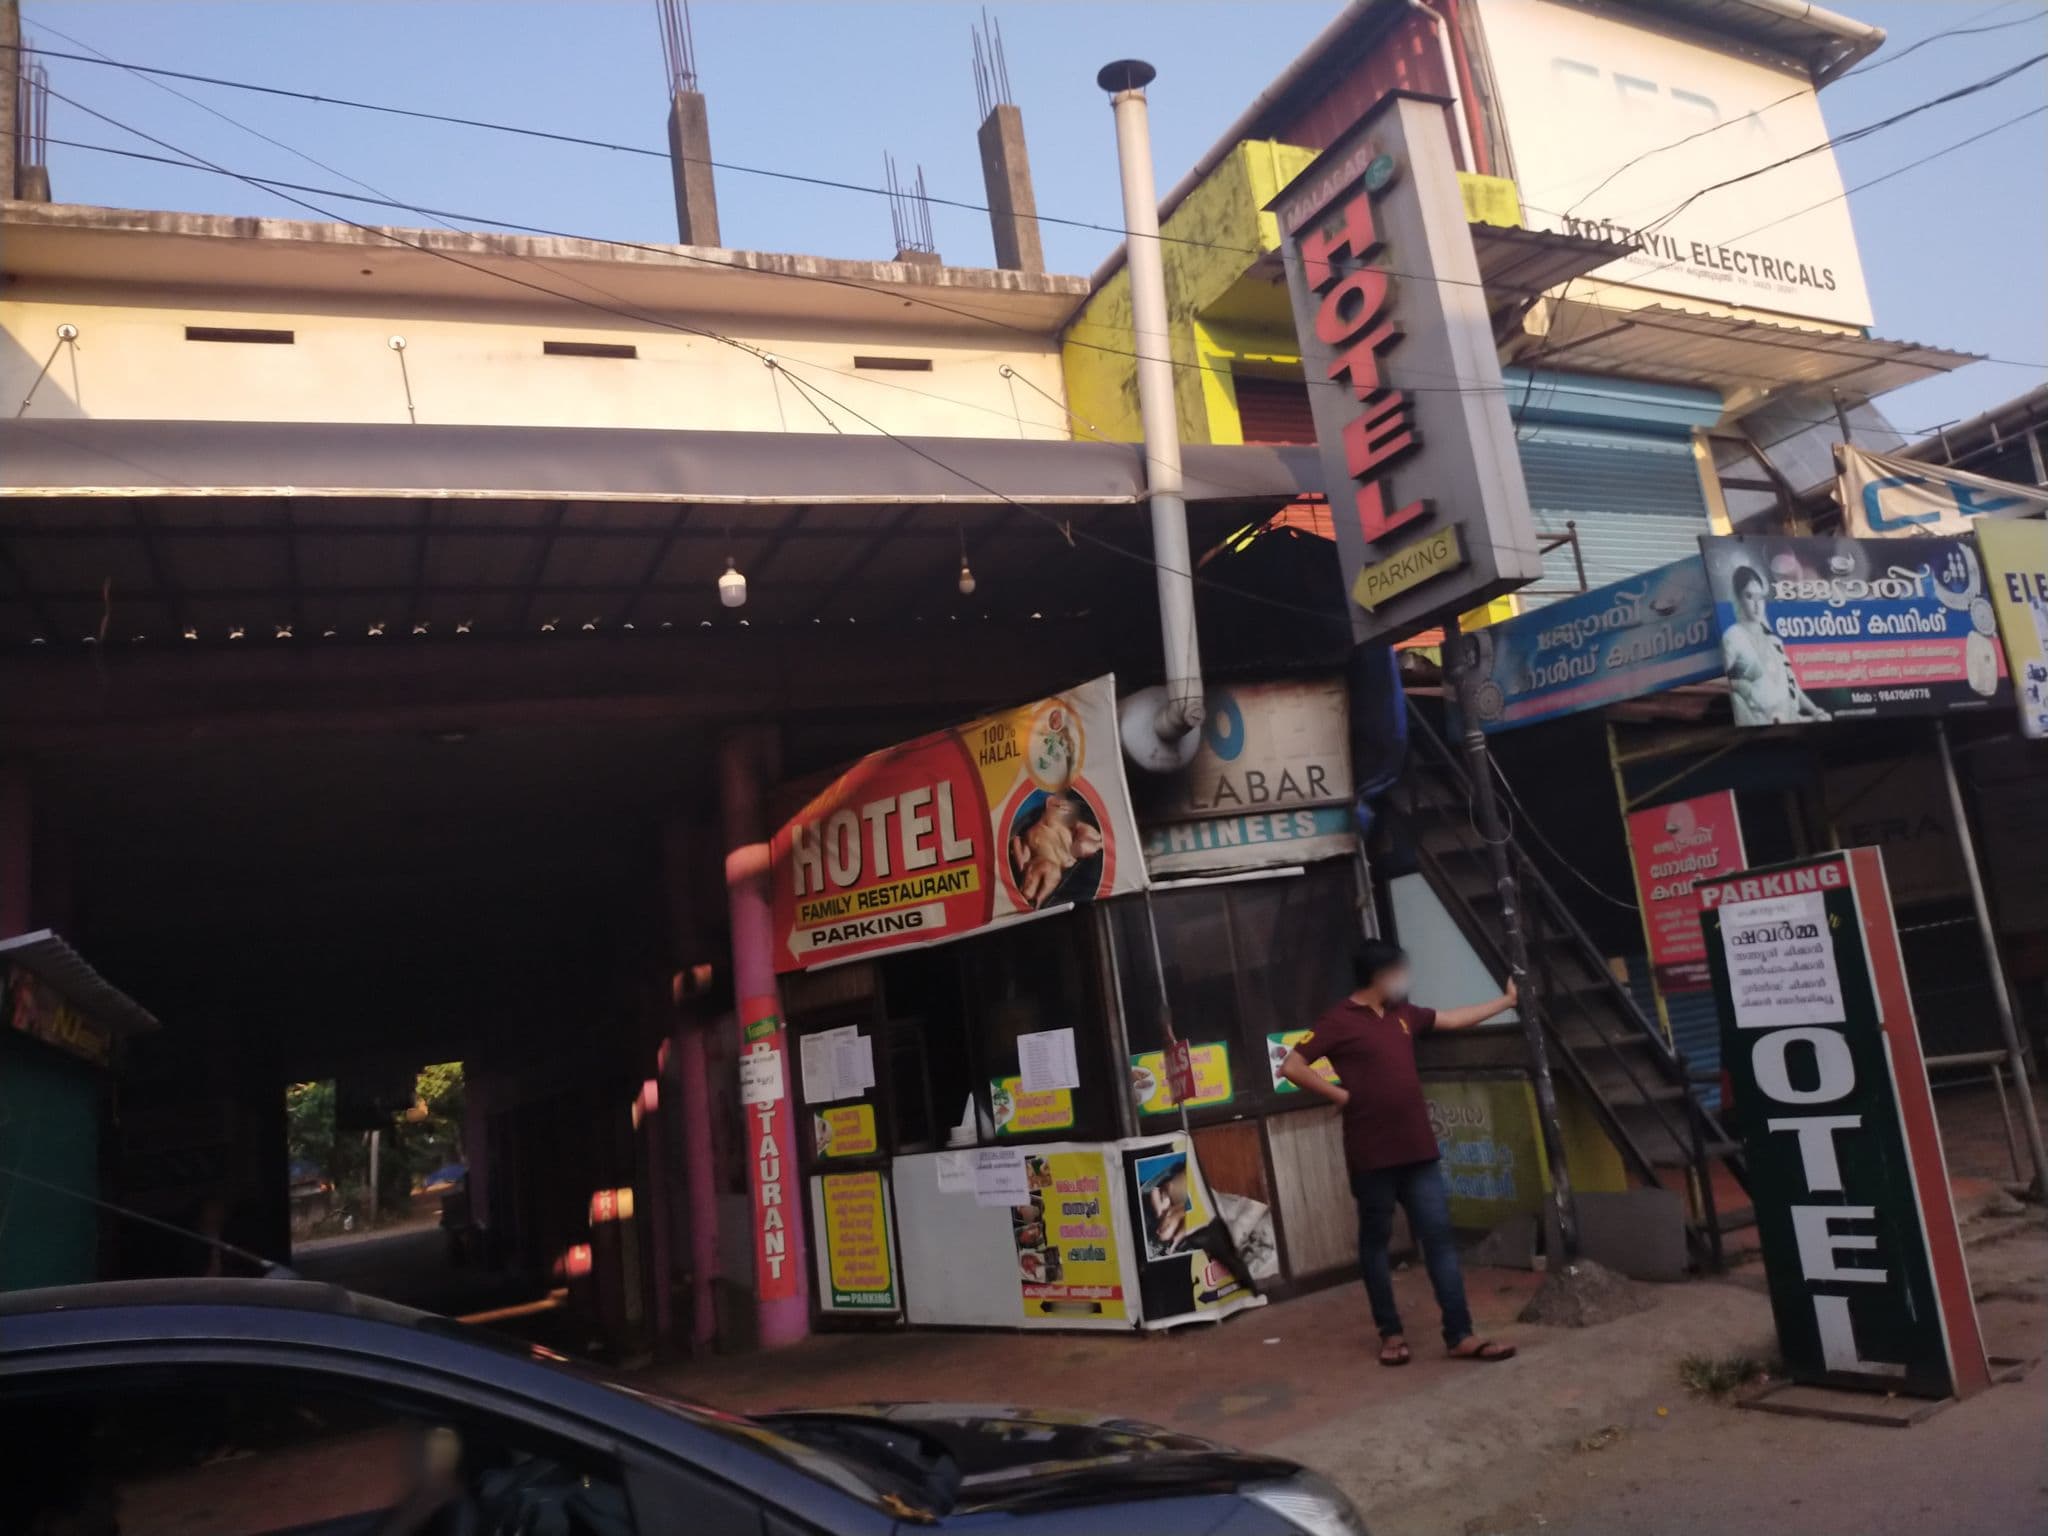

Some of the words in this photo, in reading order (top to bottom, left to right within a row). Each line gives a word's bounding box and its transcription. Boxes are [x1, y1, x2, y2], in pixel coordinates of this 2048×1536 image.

[1691, 242, 1836, 291] ELECTRICALS
[1302, 192, 1427, 544] HOTEL
[1366, 540, 1447, 596] PARKING
[1776, 609, 1862, 637] ഗോൾഡ്
[1867, 606, 1948, 634] കവറിംഗ്
[979, 741, 1020, 768] HALAL
[981, 726, 1016, 747] 100%
[1192, 765, 1333, 810] LABAR
[792, 780, 974, 898] HOTEL
[1155, 810, 1317, 854] HINEES
[801, 895, 852, 923] FAMILY
[857, 870, 971, 911] RESTAURANT
[1701, 864, 1842, 907] PARKING
[811, 910, 924, 947] PARKING
[752, 1042, 786, 1280] TAURANT
[1751, 1026, 1906, 1378] OTEL
[850, 1292, 892, 1305] PARKING
